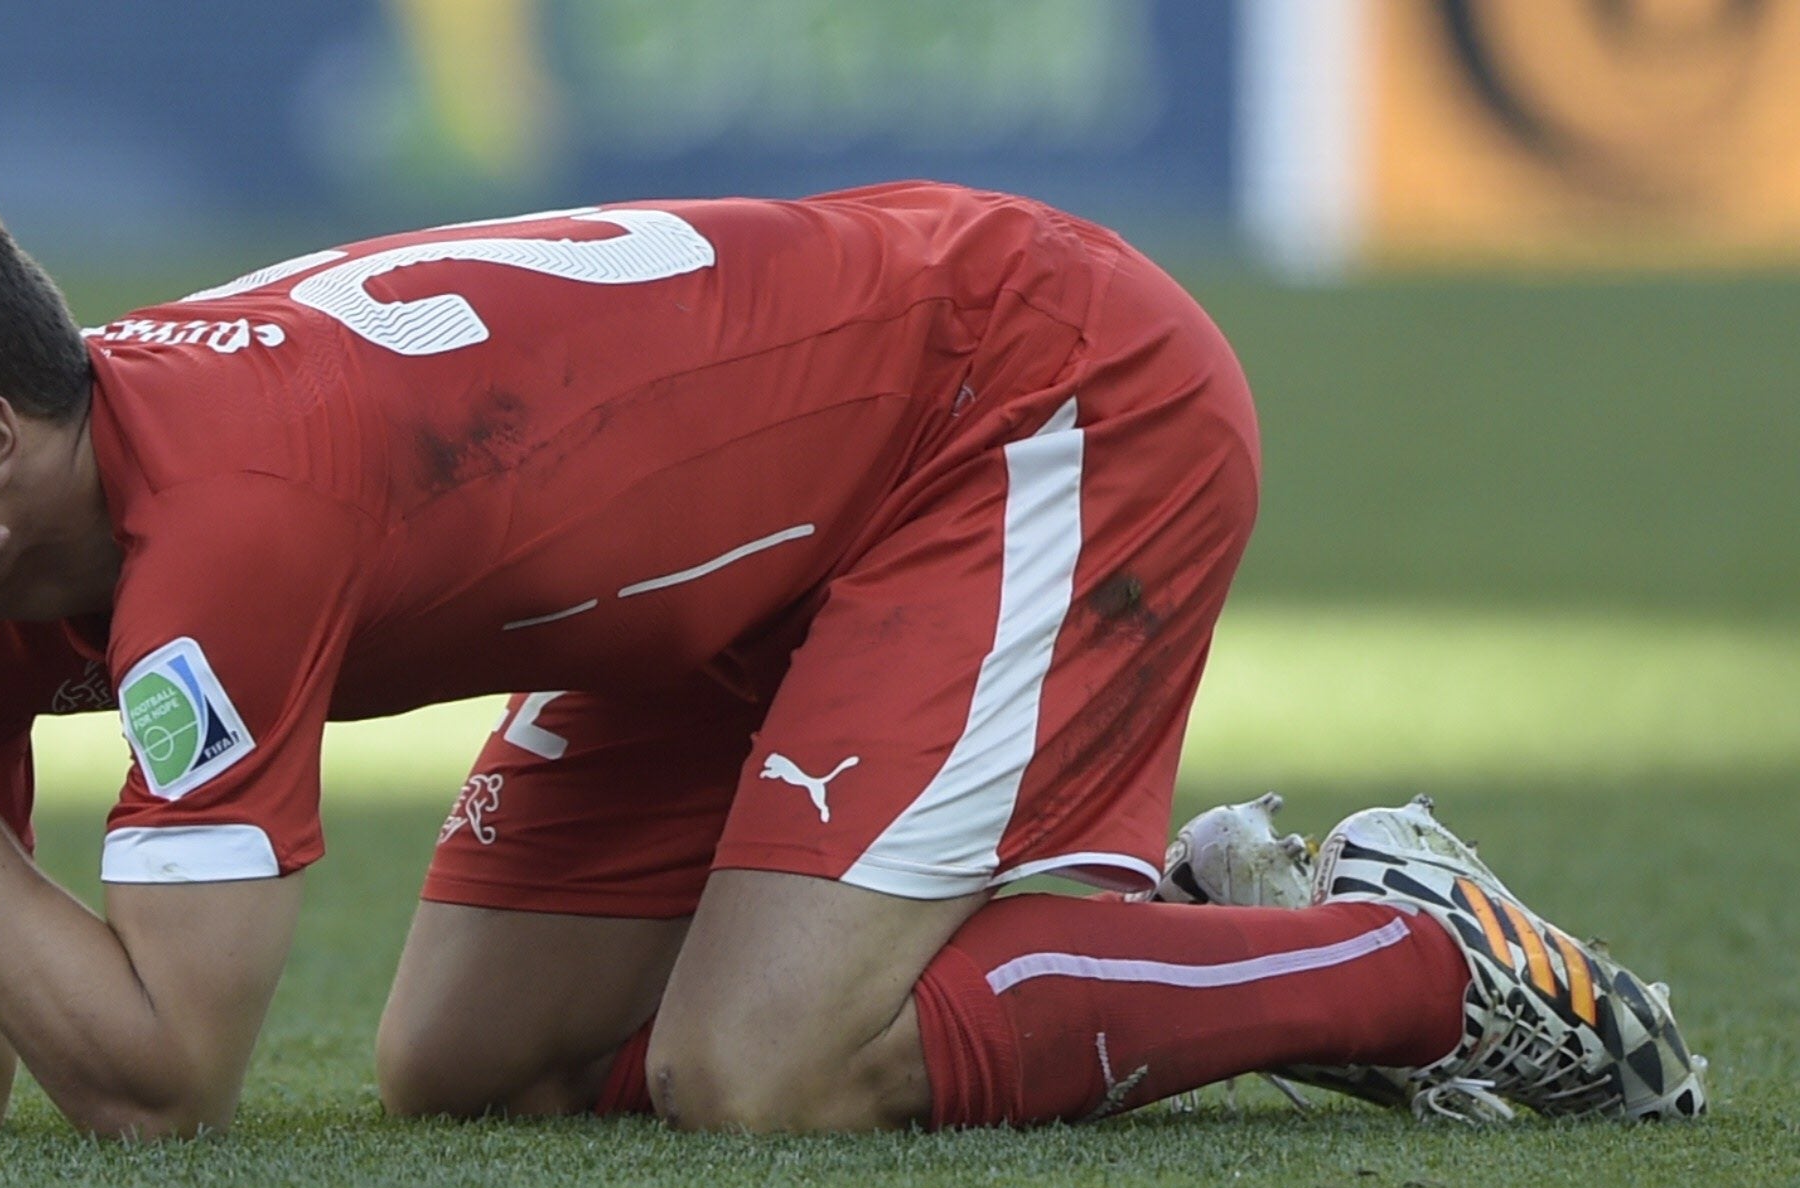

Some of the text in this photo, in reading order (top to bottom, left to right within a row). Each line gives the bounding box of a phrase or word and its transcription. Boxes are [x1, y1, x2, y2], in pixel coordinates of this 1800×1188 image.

[130, 687, 176, 719] FOOTBALL
[133, 697, 180, 731] FOR HOPE
[203, 736, 232, 760] FIFA
